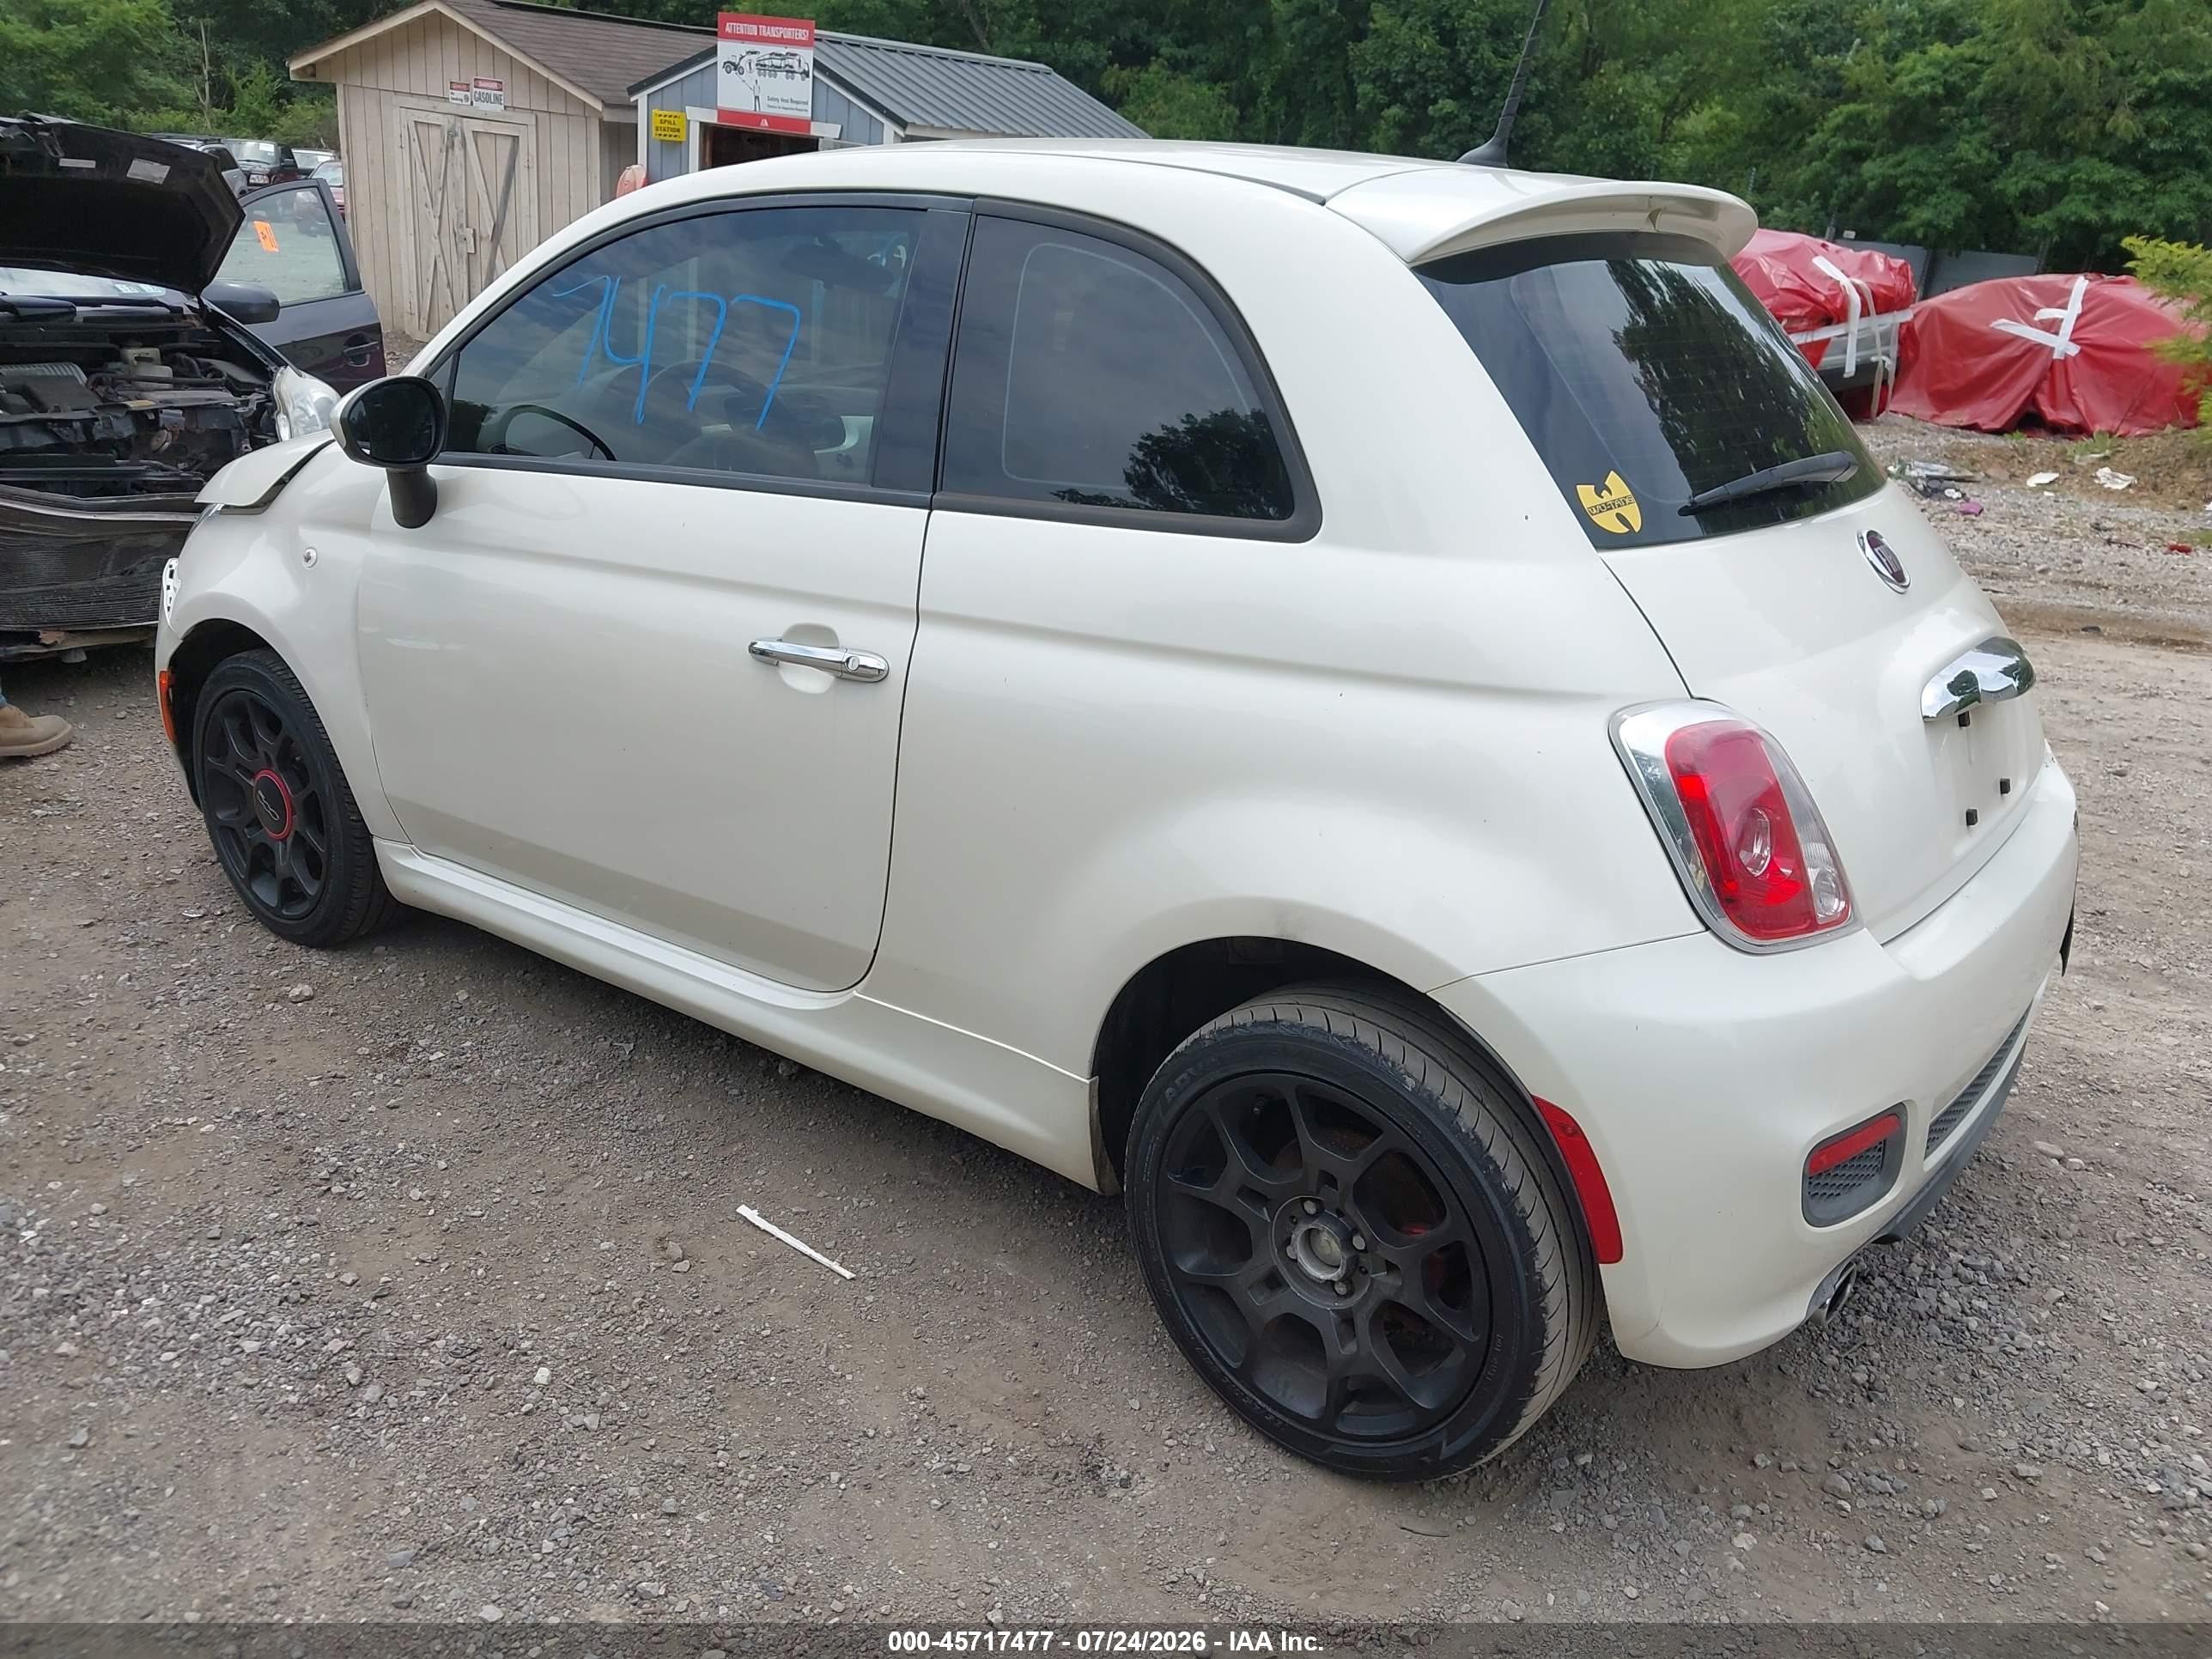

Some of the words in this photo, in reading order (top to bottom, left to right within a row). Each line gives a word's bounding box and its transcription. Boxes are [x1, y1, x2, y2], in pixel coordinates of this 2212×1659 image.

[725, 22, 757, 36] ATTENTION
[758, 25, 809, 40] TRANSPORTERS!
[474, 90, 503, 105] GASOLINE
